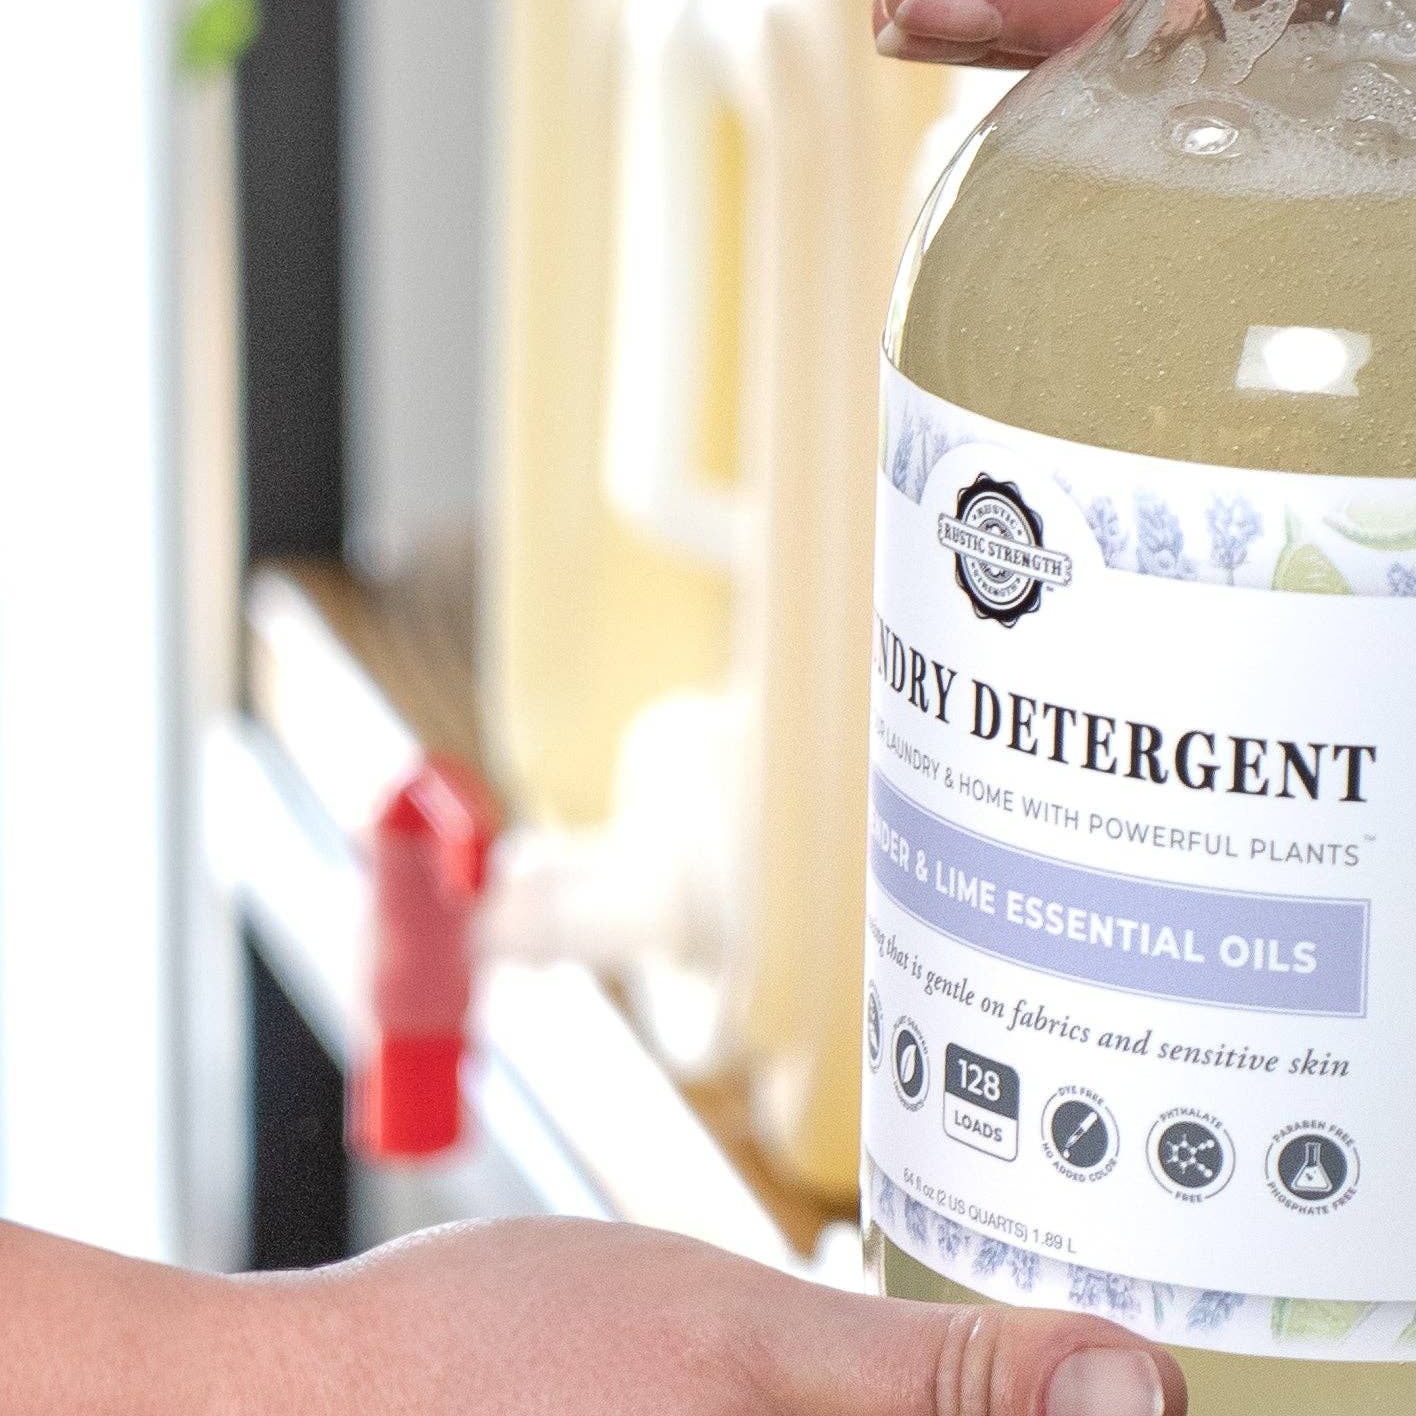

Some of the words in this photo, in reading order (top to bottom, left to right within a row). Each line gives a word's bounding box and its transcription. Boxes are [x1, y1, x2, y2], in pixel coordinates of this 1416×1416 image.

[943, 521, 986, 555] RUSTIC
[987, 540, 1063, 577] STRENGTH
[876, 614, 957, 724] NDRY
[970, 679, 1377, 803] DETERGENT
[887, 728, 940, 780] LAUNDRY
[945, 766, 954, 789] &
[959, 773, 1013, 812] HOME
[1022, 795, 1079, 831] WITH
[1088, 813, 1238, 857] POWERFUL
[915, 849, 928, 882] &
[935, 859, 996, 915] LIME
[1006, 888, 1206, 963] ESSENTIAL
[1219, 934, 1318, 975] OILS
[886, 934, 909, 970] that
[912, 955, 922, 979] is
[924, 970, 975, 1005] gentle
[981, 996, 1004, 1018] on
[1007, 999, 1091, 1043] fabrics
[1098, 1031, 1153, 1055] and
[1157, 1041, 1279, 1073] sensitive
[1288, 1048, 1350, 1077] skin
[958, 1057, 1001, 1102] 128
[1058, 1085, 1077, 1098] DYE
[1079, 1087, 1105, 1107] FREE
[954, 1109, 1003, 1143] LOADS
[1159, 1107, 1224, 1130] PHTHALATE
[1042, 1142, 1055, 1160] NO
[1052, 1159, 1086, 1184] ADDED
[1088, 1157, 1118, 1183] COLOR
[902, 1167, 914, 1186] 64
[950, 1195, 966, 1215] US
[968, 1205, 1030, 1243] QUARTS)
[1033, 1229, 1064, 1251] 1.89
[1068, 1238, 1078, 1255] L
[1175, 1191, 1205, 1203] FREE
